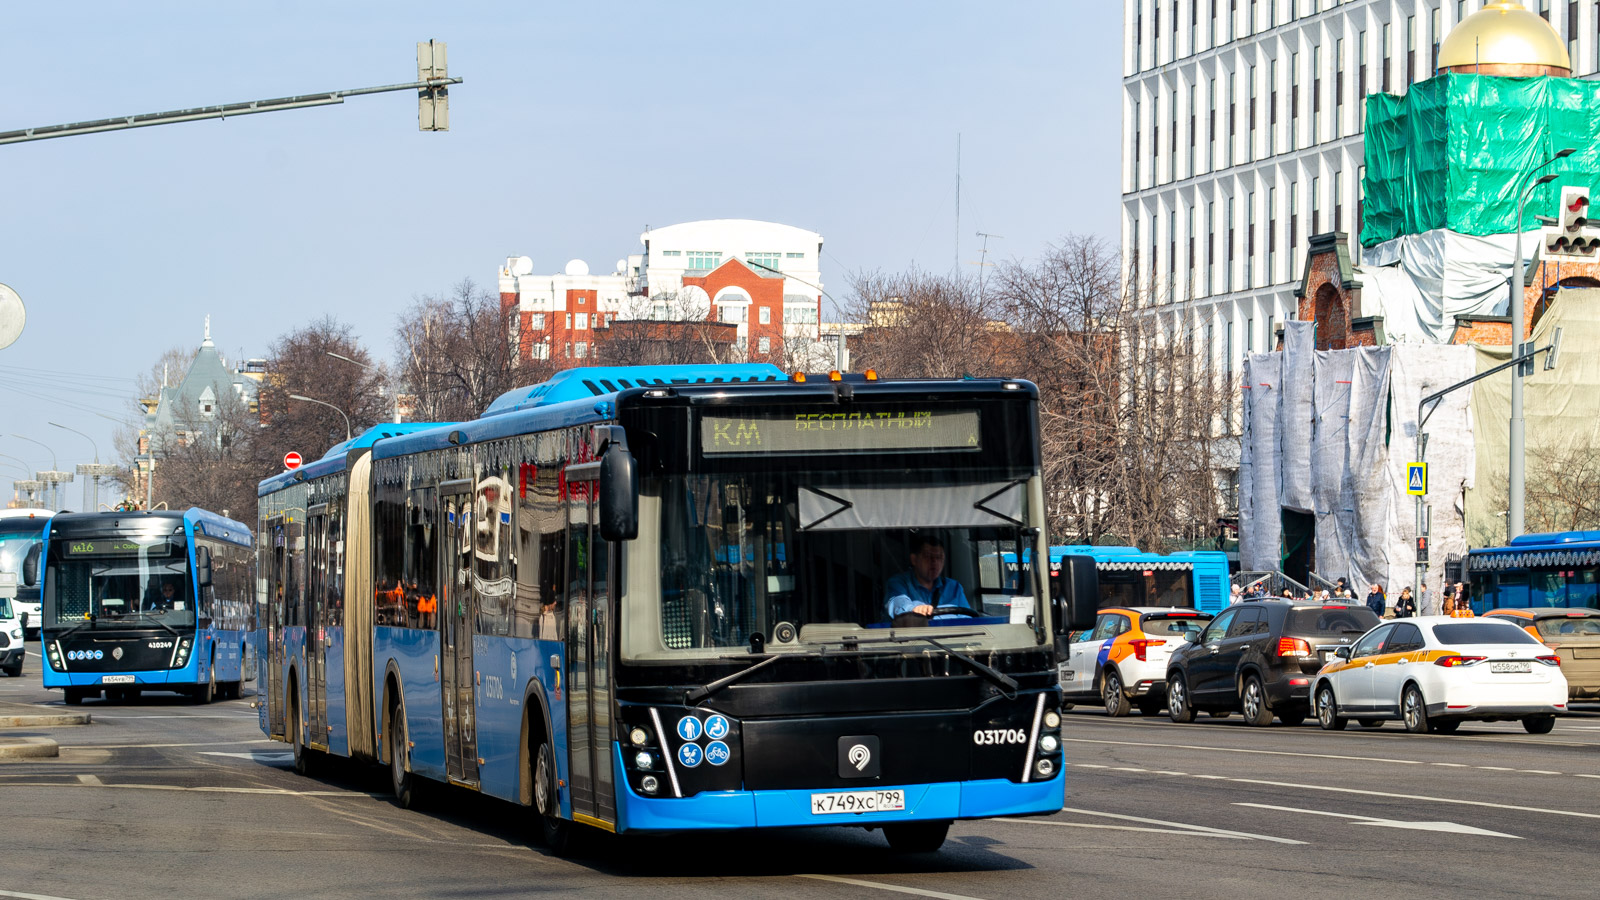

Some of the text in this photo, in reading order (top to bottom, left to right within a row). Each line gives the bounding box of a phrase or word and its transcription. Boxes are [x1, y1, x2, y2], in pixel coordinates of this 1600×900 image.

[795, 411, 932, 431] БЕСПЛАТНЫЙ
[714, 419, 761, 446] КМ
[973, 728, 1027, 746] 031706
[816, 791, 900, 812] К749ХС 799
